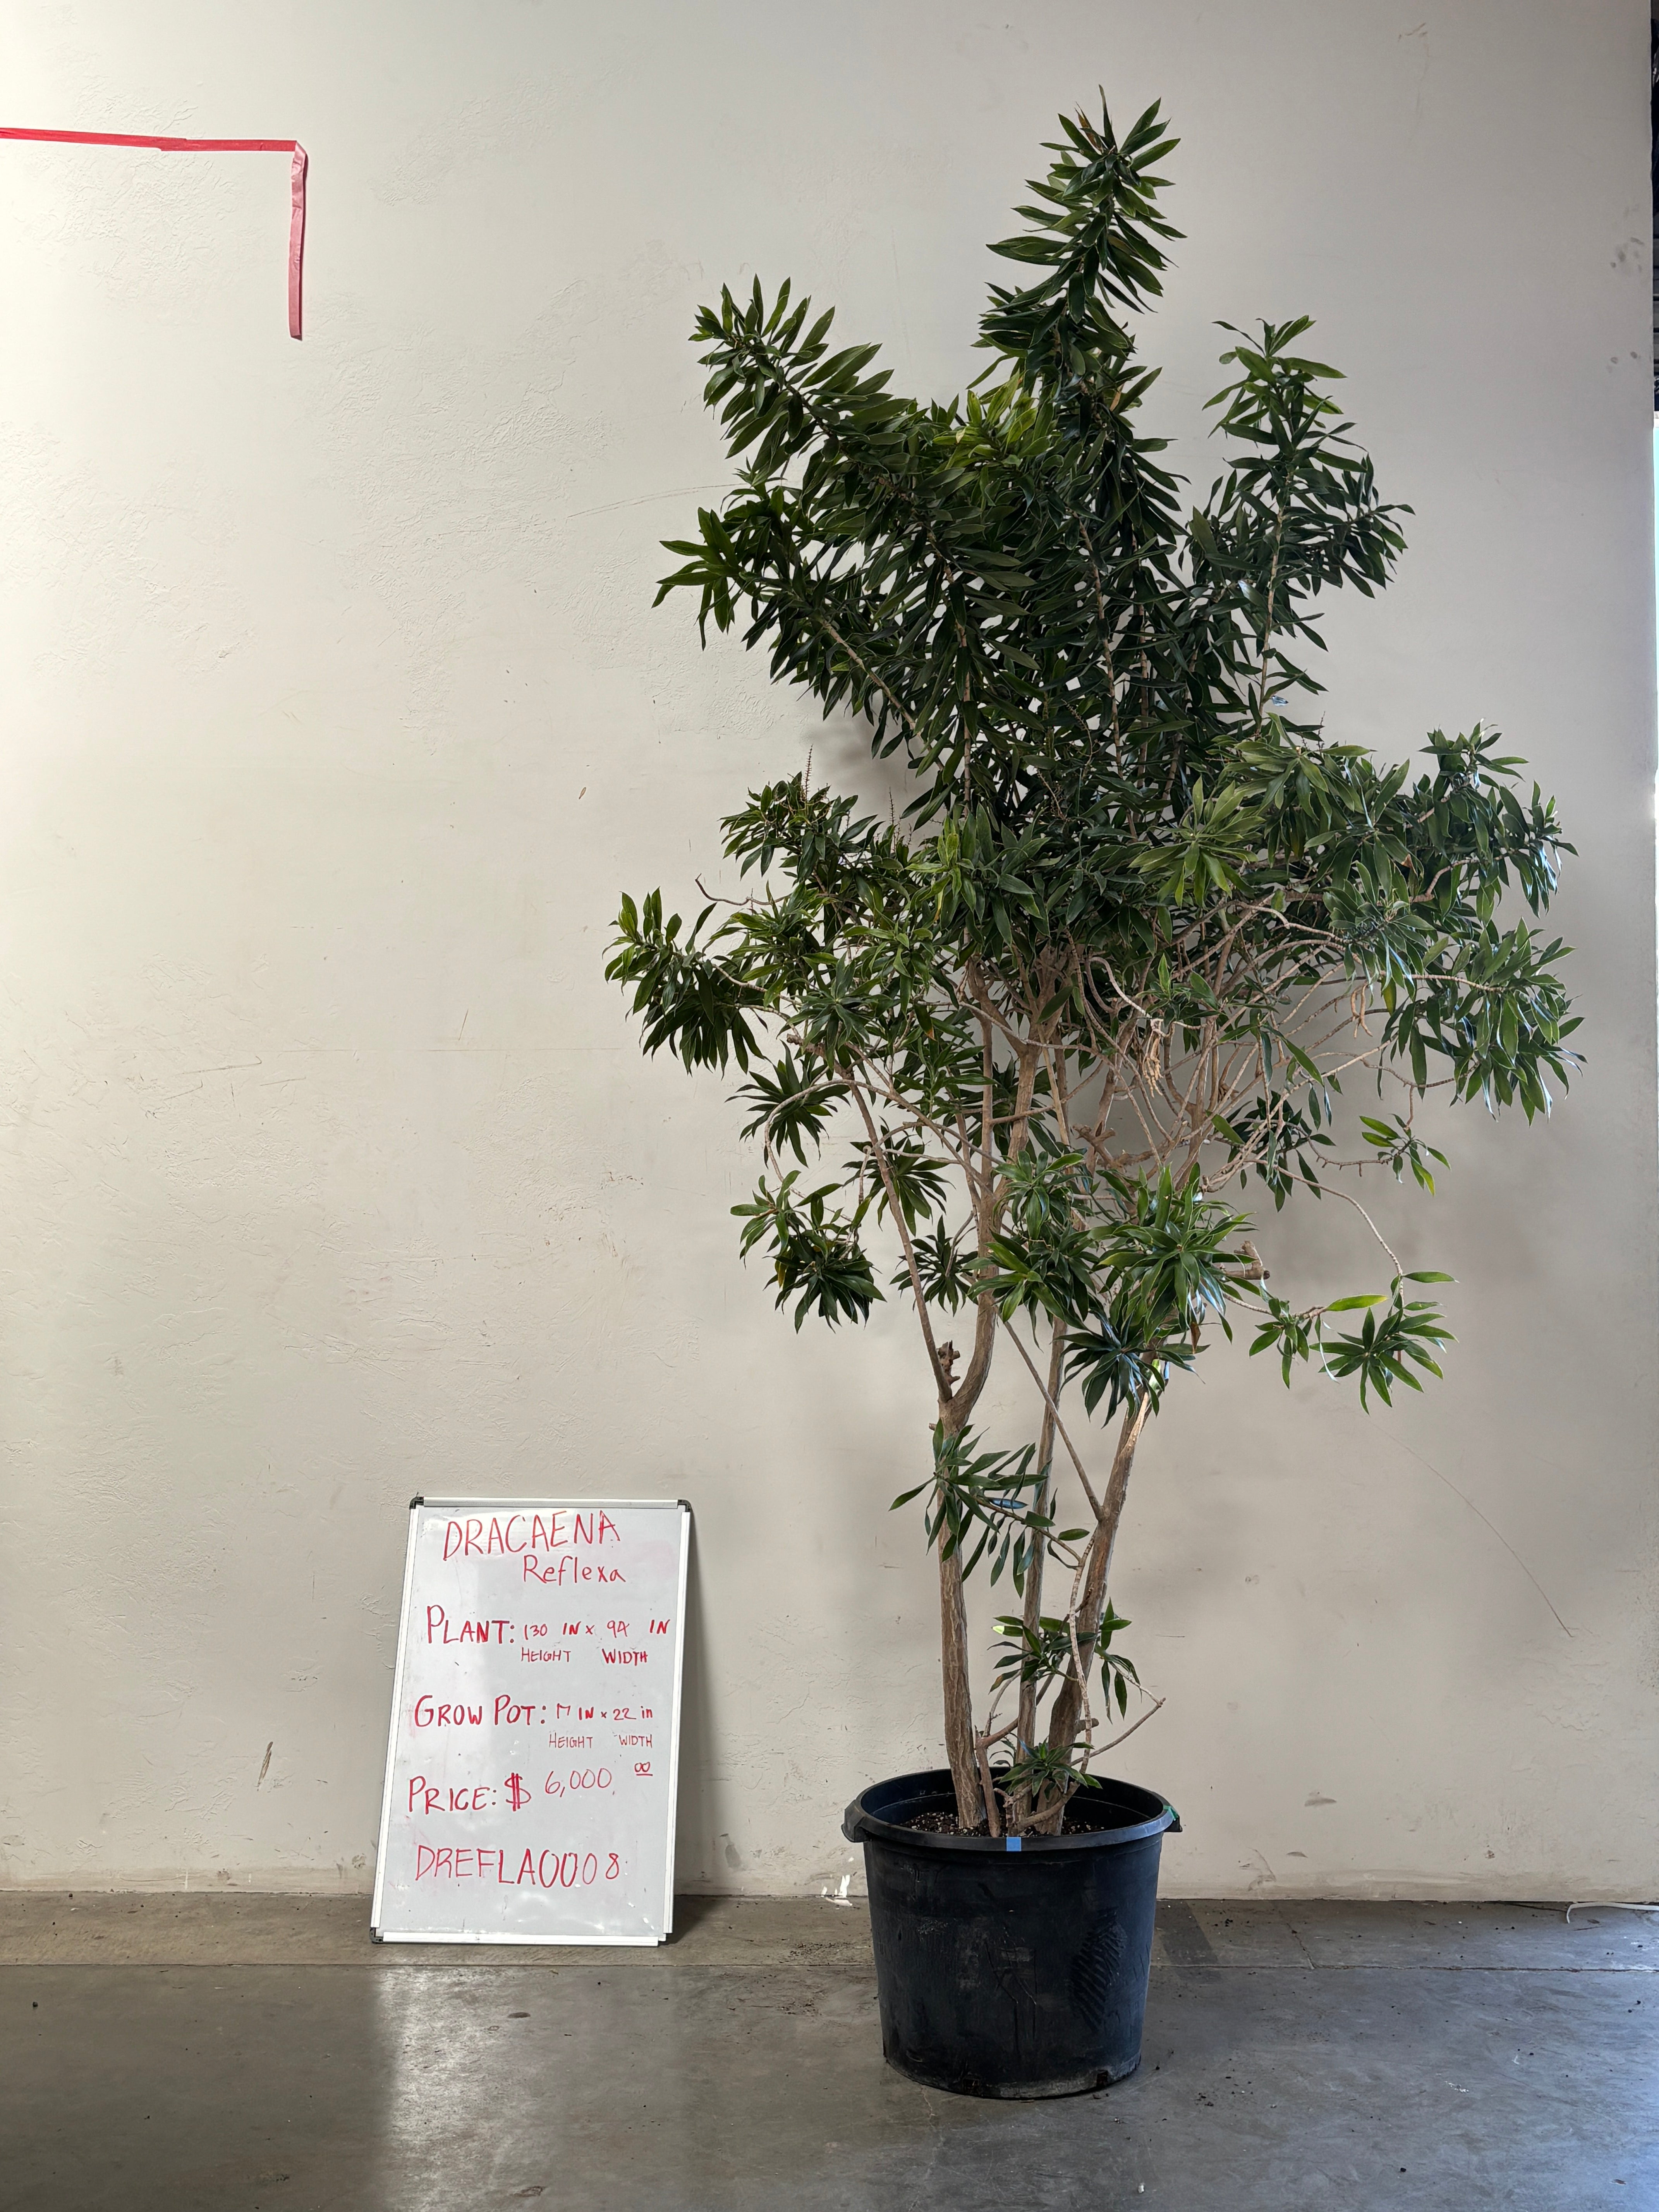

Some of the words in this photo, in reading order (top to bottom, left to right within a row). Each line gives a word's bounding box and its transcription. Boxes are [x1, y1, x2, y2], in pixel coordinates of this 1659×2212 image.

[443, 1510, 620, 1561] DRACAENA
[523, 1554, 626, 1586] Reflexa
[426, 1605, 515, 1645] PLANT:
[524, 1623, 548, 1641] 130
[562, 1621, 582, 1635] IN
[649, 1619, 670, 1635] IN
[521, 1647, 572, 1663] HEIGHT
[602, 1649, 649, 1666] WIDTH
[414, 1695, 483, 1728] GROW
[494, 1694, 546, 1726] POT:
[578, 1706, 594, 1721] IN
[613, 1708, 637, 1721] 22
[640, 1705, 654, 1719] in
[549, 1732, 593, 1748] HEIGHT
[618, 1733, 653, 1748] WIDTH
[409, 1775, 497, 1815] PRICE:
